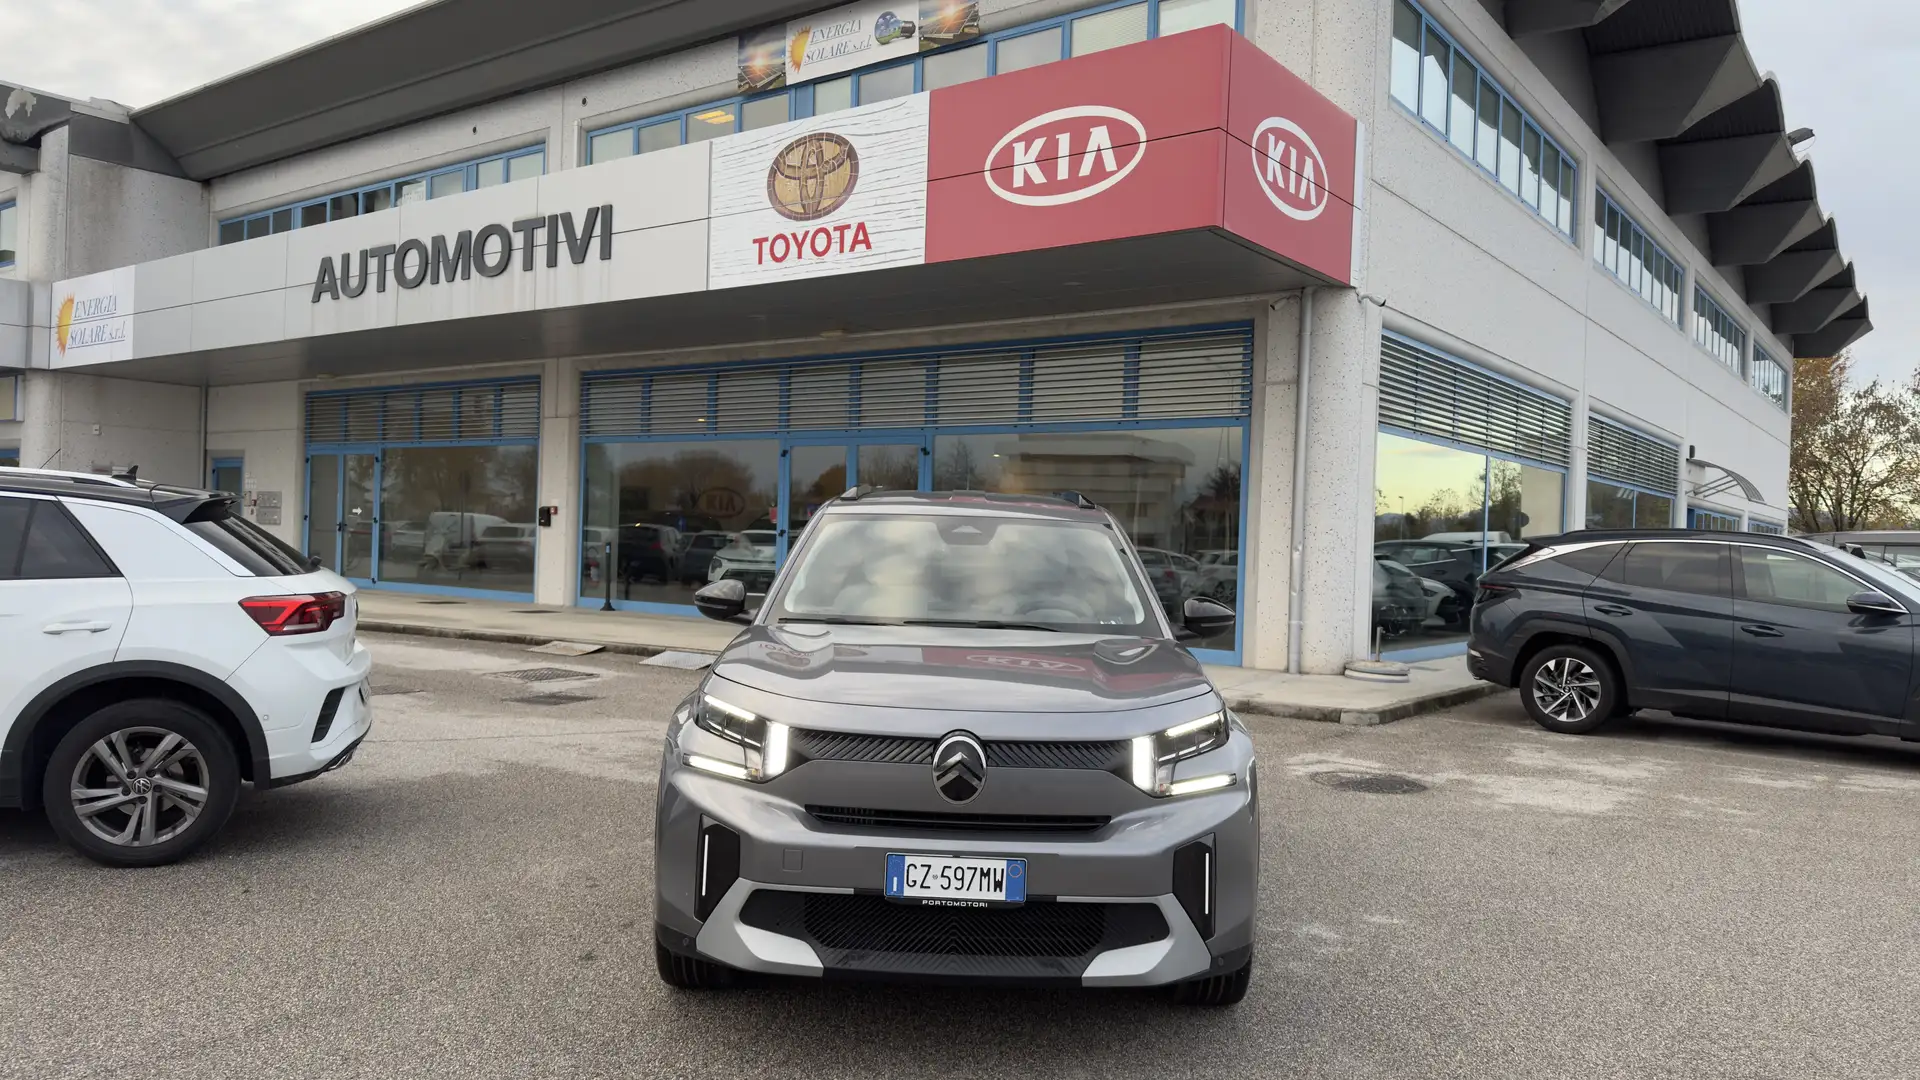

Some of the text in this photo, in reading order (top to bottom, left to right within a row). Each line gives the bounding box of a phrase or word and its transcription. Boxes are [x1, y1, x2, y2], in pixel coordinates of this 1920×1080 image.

[810, 19, 863, 44] ENERGIA
[804, 41, 851, 63] SOLARE
[1012, 125, 1118, 188] KIA
[1266, 132, 1317, 206] KIA
[311, 204, 613, 303] AUTOMOTIVI
[752, 221, 872, 265] TOYOTA
[73, 295, 117, 319] ENERGIA
[68, 324, 109, 347] SOLARE
[905, 863, 932, 889] GZ
[940, 865, 1005, 893] 597MW
[922, 899, 988, 908] PORTOMOTORI
